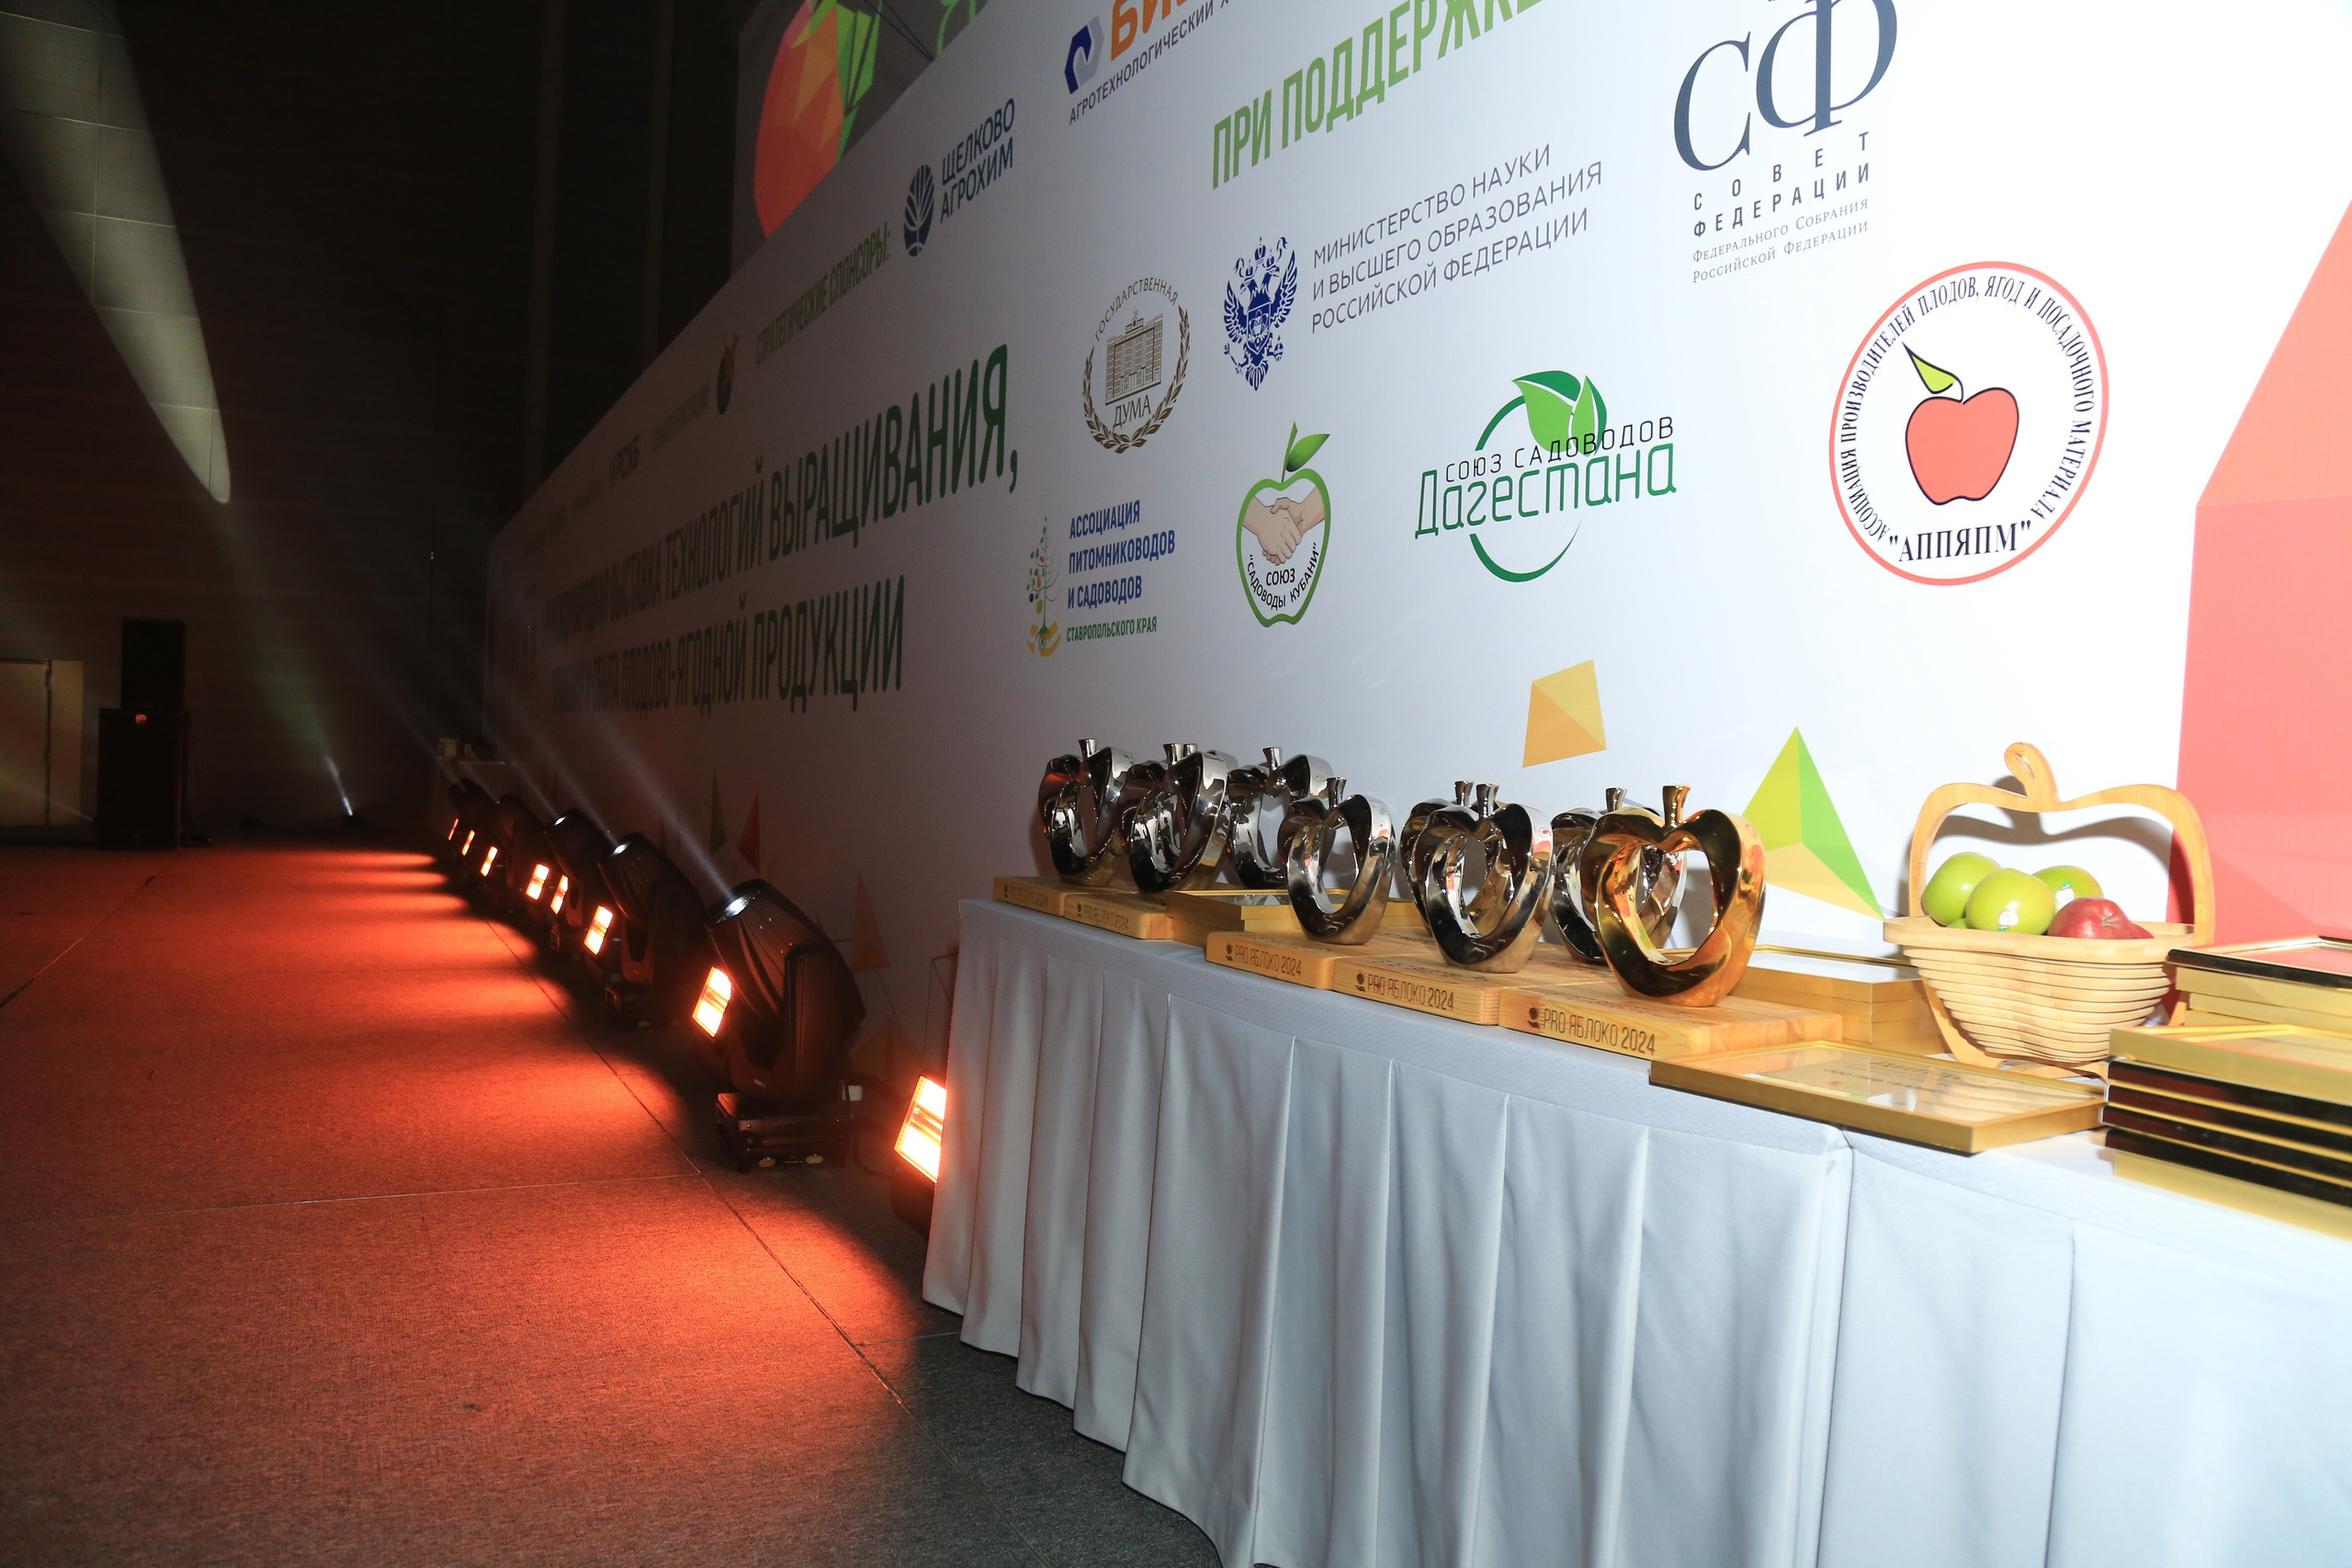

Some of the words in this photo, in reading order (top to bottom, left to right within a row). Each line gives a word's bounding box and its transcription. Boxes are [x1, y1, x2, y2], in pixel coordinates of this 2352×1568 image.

[1211, 88, 1272, 190] ПРИ
[1282, 0, 1544, 150] ПОДДЕРЖ
[1673, 0, 1898, 171] СФ
[940, 136, 1014, 224] АГРОХИМ
[942, 97, 1015, 186] ЩЕЛКОВО
[1693, 131, 1870, 210] СОВЕТ
[1312, 278, 1324, 301] И
[1329, 238, 1421, 296] ВЫСШЕГО
[1428, 160, 1602, 253] ОБРАЗОВАНИЯ
[1313, 183, 1465, 268] МИНИСТЕРСТВО
[1472, 142, 1551, 198] НАУКИ
[1693, 163, 1870, 238] ФЕДЕРАЦИИ
[828, 220, 891, 307] СПОНСОРЫ:
[1312, 261, 1437, 334] РОССИЙСКОЙ
[1443, 207, 1588, 282] ФЕДЕРАЦИИ
[1917, 276, 1980, 317] ПЛОДОВ,
[1984, 276, 2025, 308] ЯГОД
[2023, 287, 2041, 310] И
[1094, 277, 1179, 342] ГОСУДАРСТВЕННАЯ
[1840, 303, 1916, 444] ПРОИЗВОДИТЕЛЕЙ
[2036, 297, 2096, 413] ПОСАДОЧНОГО
[1113, 394, 1152, 433] ДУМА
[1445, 453, 1501, 482] СОЮЗ
[1514, 416, 1674, 468] САДОВОДОВ
[665, 454, 764, 603] ТЕХНОЛОГИЙ
[769, 343, 1018, 562] ВЫРАЩИВАНИЯ,
[1415, 443, 1677, 539] Дагестана
[1840, 447, 1891, 543] АССОЦИАЦИЯ
[2030, 420, 2093, 520] МАТЕРИАЛА
[1069, 500, 1140, 539] АССОЦИАЦИЯ
[1069, 530, 1175, 574] ПИТОМНИКОВОДОВ
[1068, 588, 1075, 609] И
[1077, 575, 1142, 609] САДОВОДОВ
[1265, 568, 1295, 587] СОЮЗ
[752, 574, 905, 714] ПРОДУКЦИИ
[1067, 618, 1135, 642] СТАВРОПОЛЬСКОГО
[1136, 615, 1158, 633] КРАЯ
[1114, 913, 1129, 931] 2024
[1234, 944, 1249, 964] PRO
[1250, 948, 1280, 973] ЯБЛОКО
[1281, 955, 1302, 977] 2024
[1367, 974, 1385, 996] PRO
[1387, 978, 1426, 1005] ЯБЛОКО
[1428, 987, 1454, 1011] 2024
[1544, 1008, 1566, 1034] PRO
[1568, 1014, 1619, 1047] ЯБЛОКО
[1621, 1026, 1656, 1056] 2024
